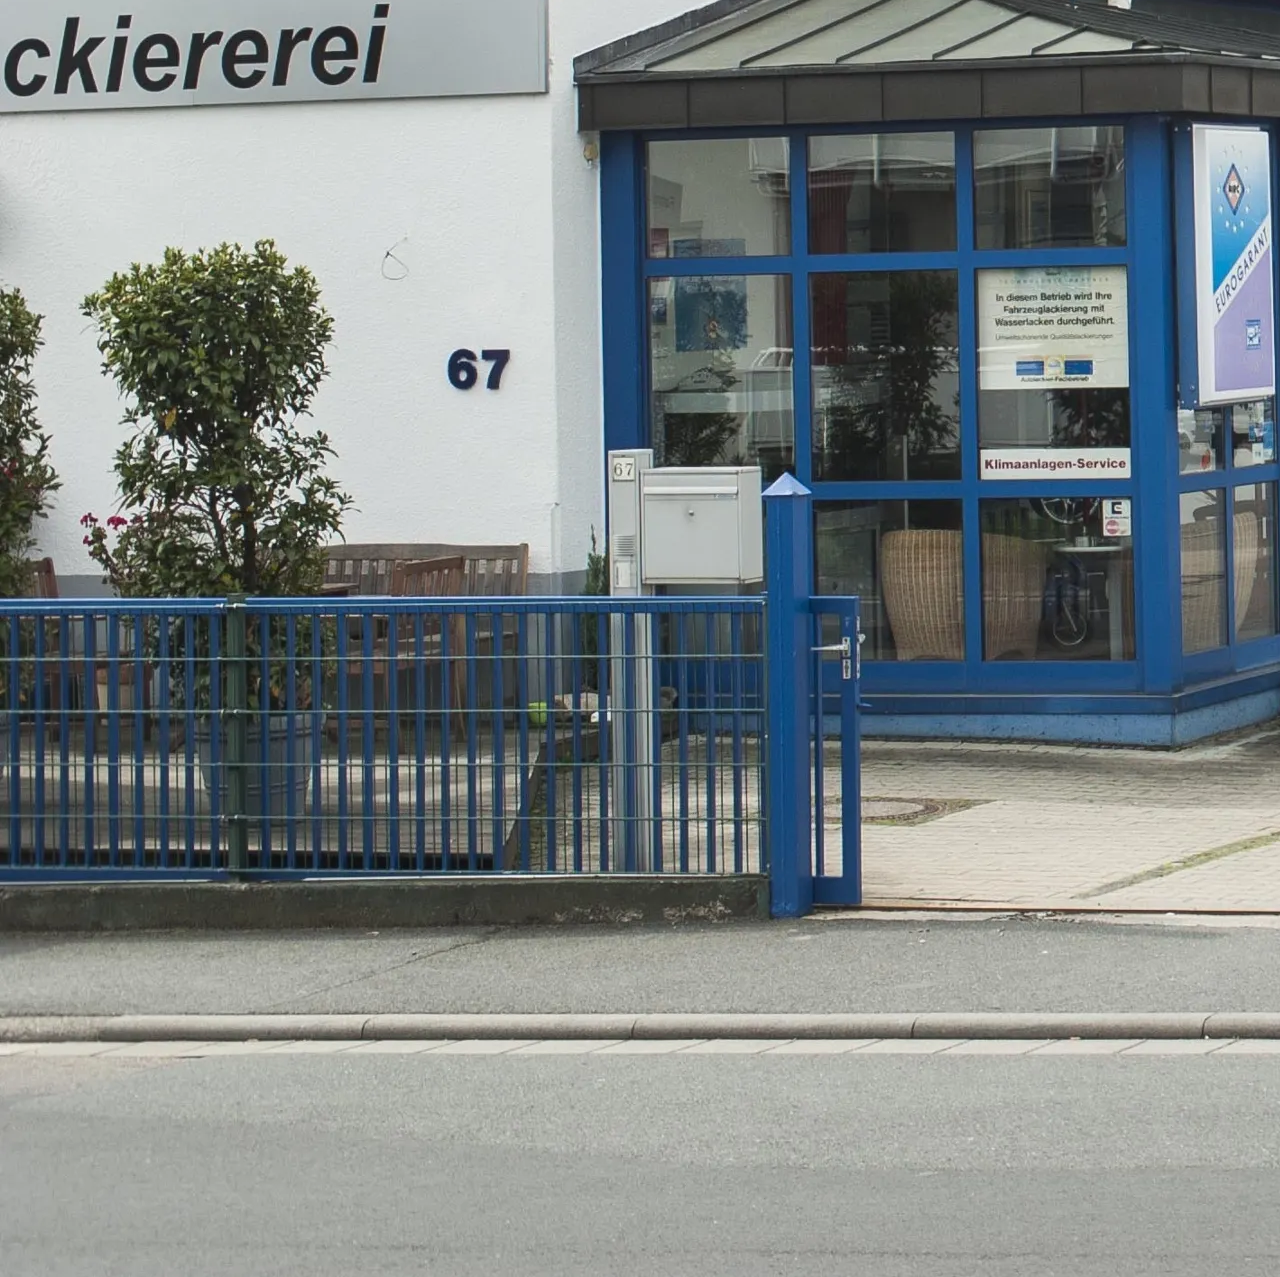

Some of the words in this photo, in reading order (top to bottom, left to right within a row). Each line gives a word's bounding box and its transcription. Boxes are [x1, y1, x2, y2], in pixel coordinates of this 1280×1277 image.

[4, 3, 390, 97] ckiererei
[1215, 226, 1269, 314] EUROGARANT
[995, 293, 1004, 302] In
[1006, 293, 1038, 302] diesem
[1040, 292, 1072, 301] Betrieb
[1074, 292, 1093, 300] wird
[1095, 292, 1112, 300] Ihre
[1003, 304, 1088, 314] Fahrzeuglackierung
[1091, 304, 1105, 312] mit
[995, 317, 1054, 327] Wasserlacken
[446, 349, 511, 390] 67
[613, 463, 633, 477] 67
[984, 457, 1127, 472] Klimaanlagen-Service
